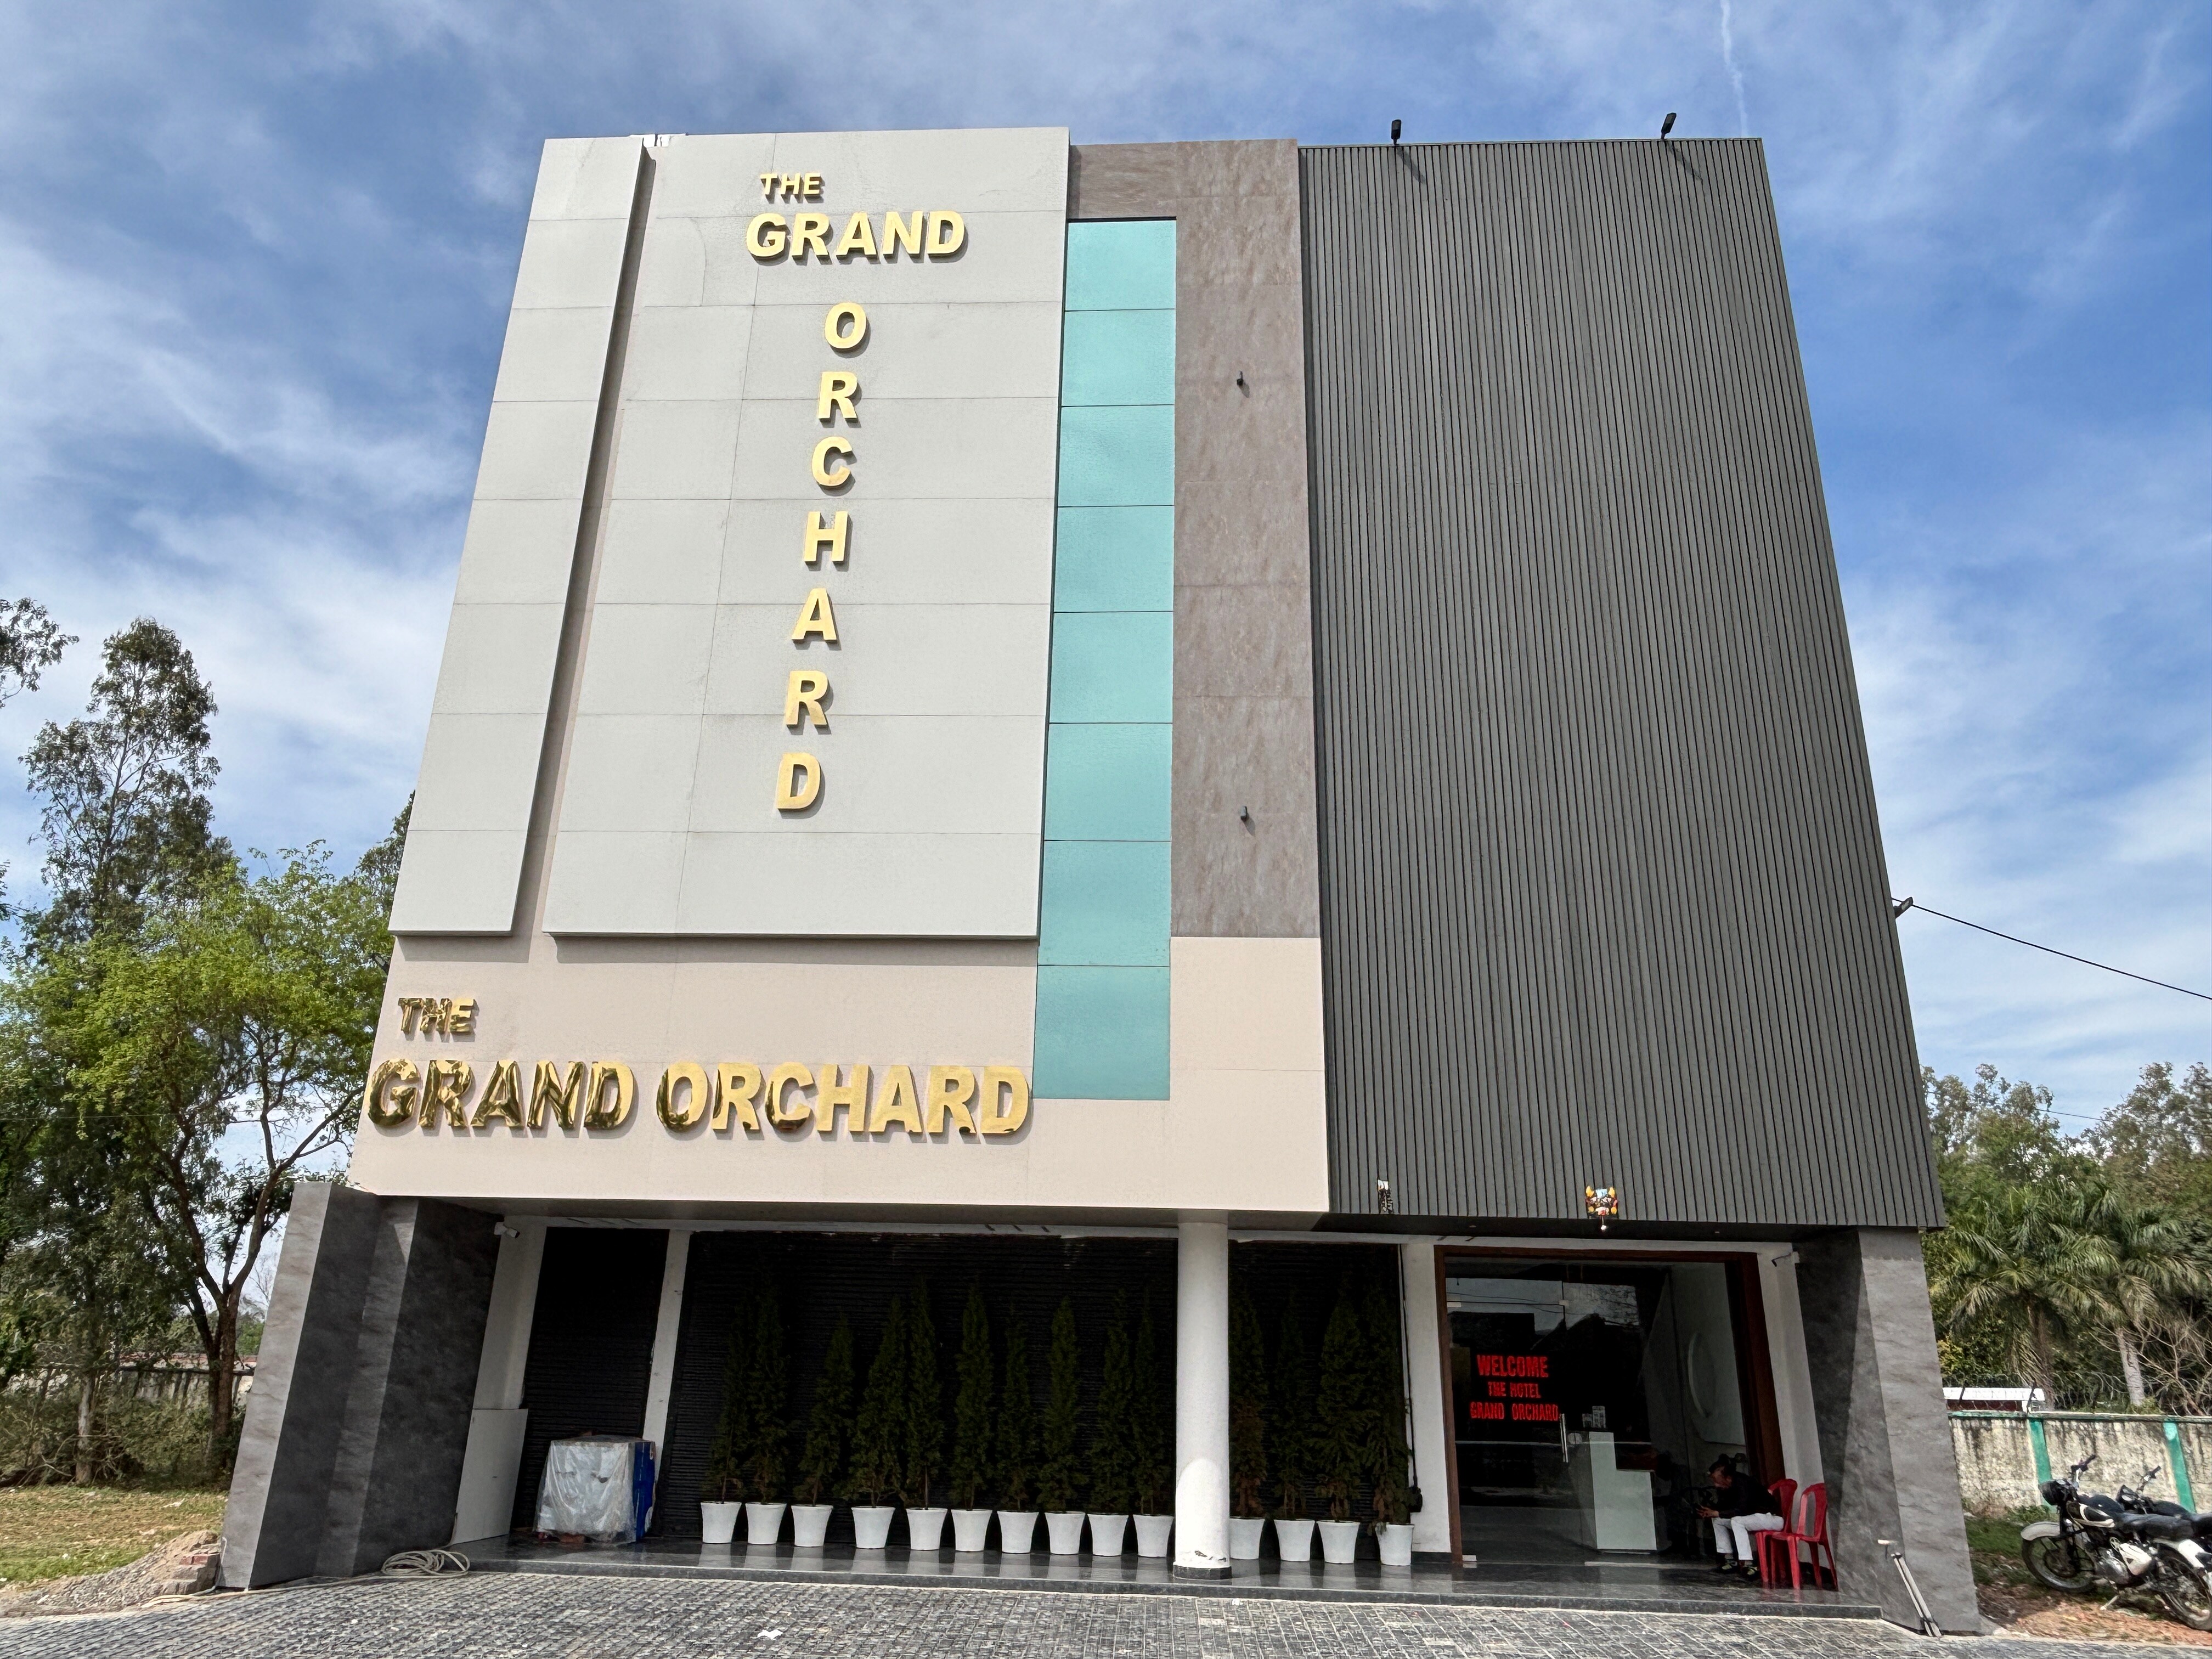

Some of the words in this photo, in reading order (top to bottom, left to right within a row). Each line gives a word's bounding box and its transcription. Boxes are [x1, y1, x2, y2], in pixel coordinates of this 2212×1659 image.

[760, 172, 821, 195] THE
[746, 211, 965, 258] GRAND
[776, 302, 867, 810] ORCHARD
[398, 998, 478, 1034] THE
[368, 1058, 635, 1130] GRAND
[656, 1062, 1030, 1133] ORCHARD
[1476, 1355, 1549, 1378] WELCOME
[1488, 1381, 1506, 1396] THE
[1510, 1383, 1541, 1398] HOTEL
[1470, 1402, 1504, 1419] GRAND
[1512, 1403, 1558, 1421] ORCHARD
